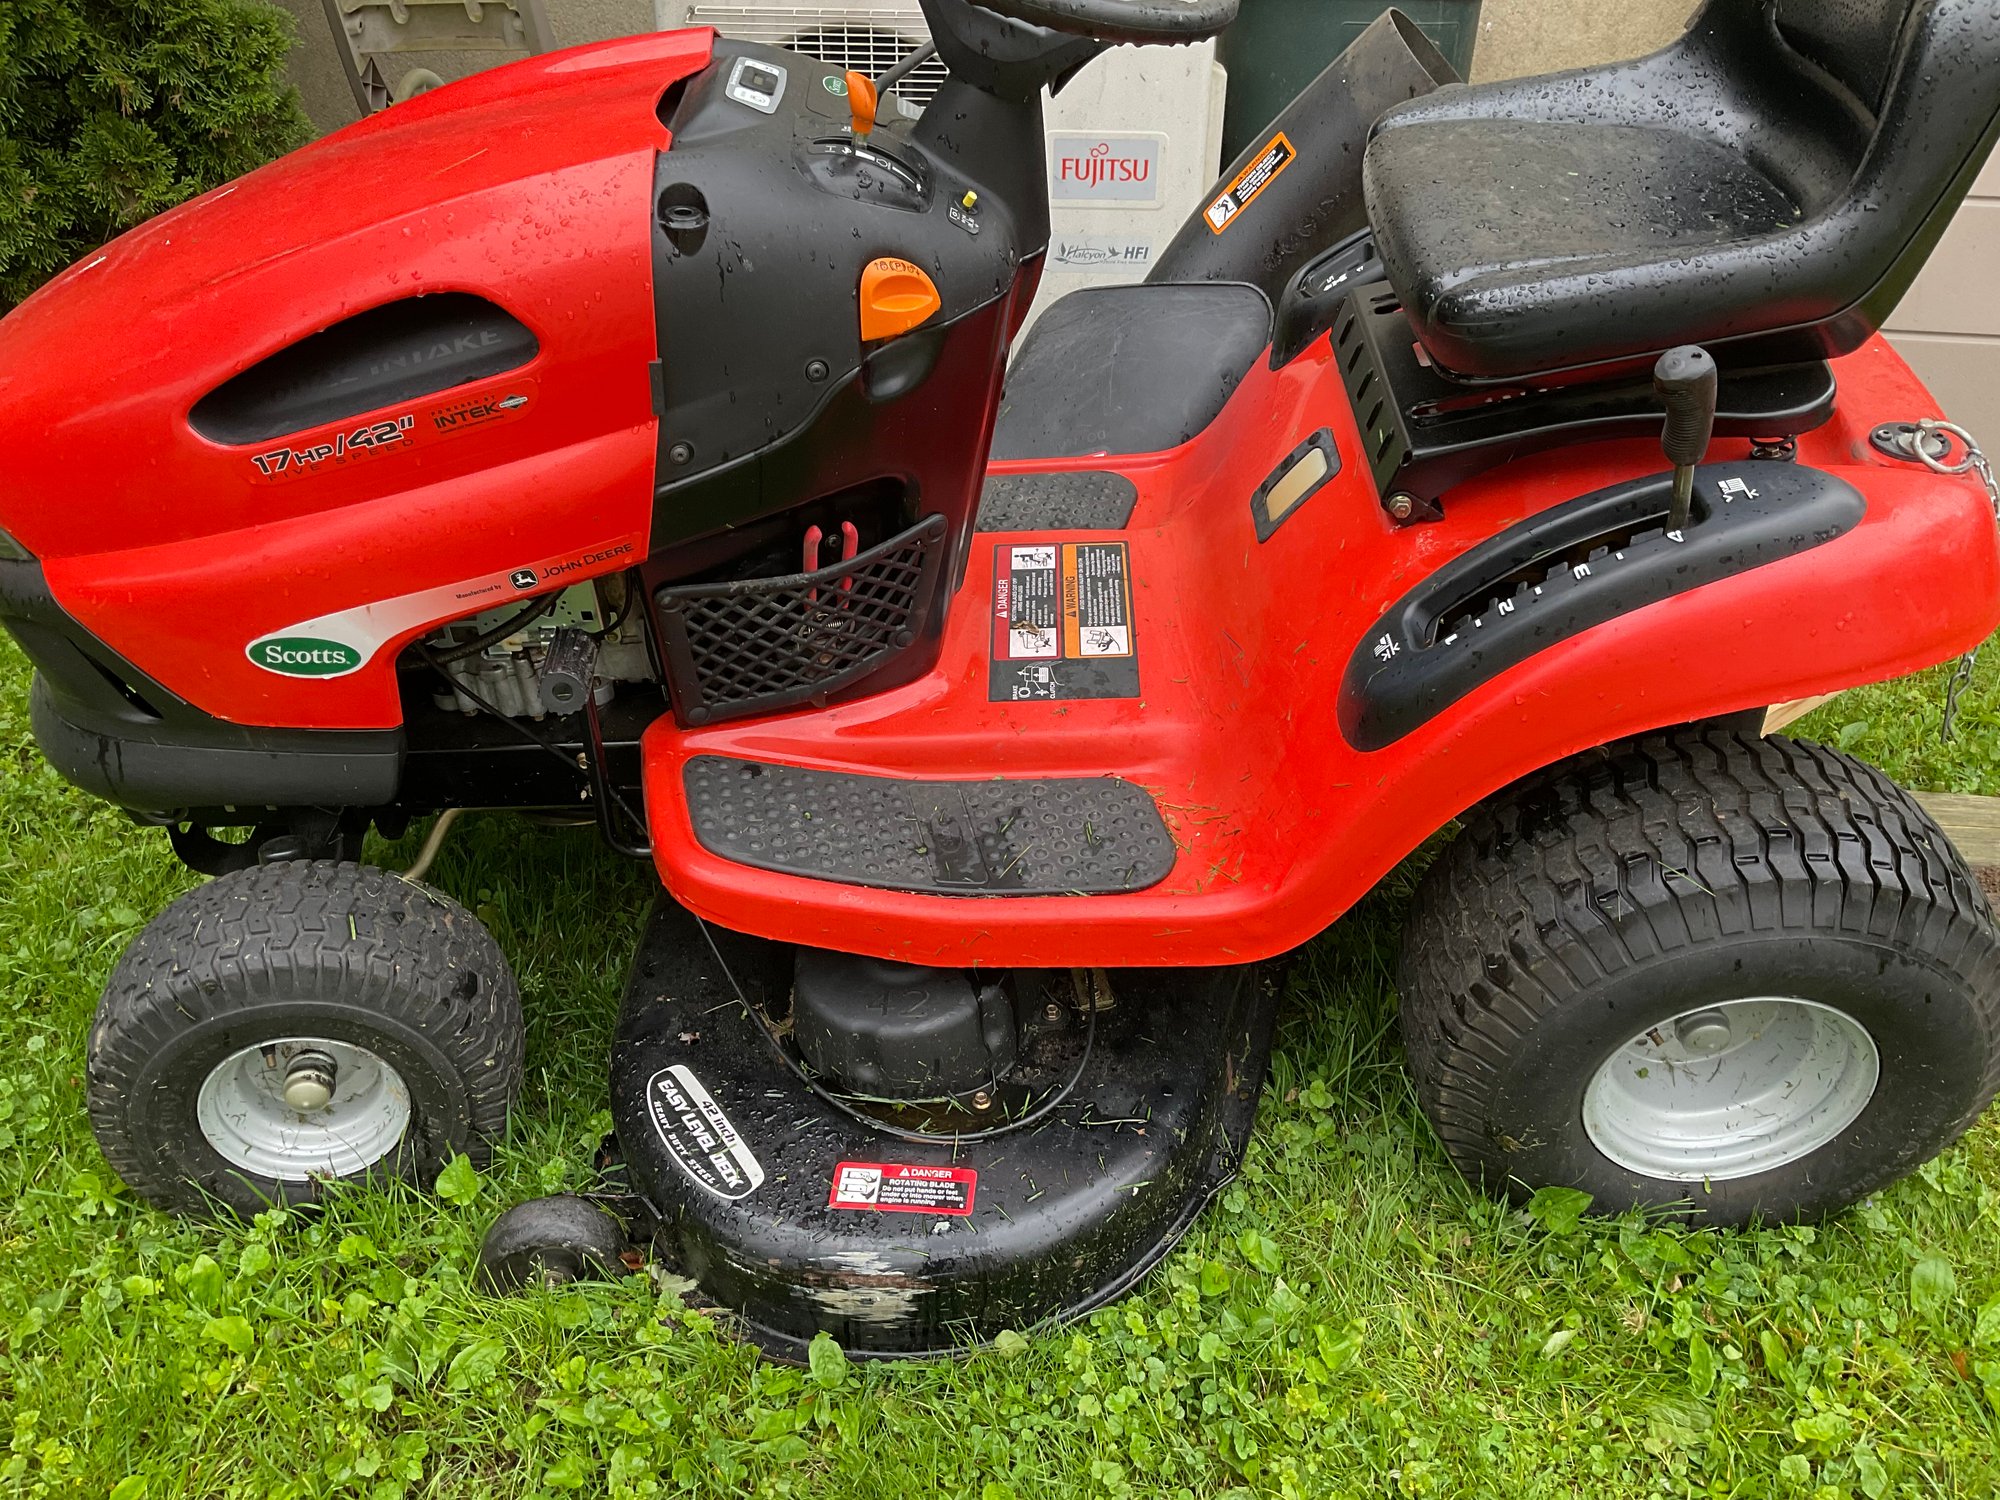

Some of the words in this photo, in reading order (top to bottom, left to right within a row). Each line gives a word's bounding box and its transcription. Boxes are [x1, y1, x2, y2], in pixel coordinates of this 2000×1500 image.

[1061, 158, 1149, 188] FUJITSU
[1243, 148, 1270, 176] WARNING
[1066, 244, 1106, 261] Halcyon
[1123, 246, 1149, 260] HFI
[433, 401, 502, 429] INTEK
[268, 462, 322, 482] FIVE
[335, 438, 415, 465] SPEED
[541, 559, 583, 580] JOHN
[582, 542, 635, 566] DEERE
[1573, 562, 1591, 580] 3
[455, 585, 494, 600] Manufactured
[494, 583, 502, 592] by
[998, 579, 1009, 609] DANGER
[1065, 576, 1076, 610] WARNING
[1498, 597, 1515, 616] 2
[1444, 633, 1458, 645] 1
[265, 645, 347, 664] Scotts
[702, 1100, 718, 1117] 42
[713, 1117, 737, 1143] inch
[653, 1101, 671, 1130] HEAVY
[668, 1133, 689, 1156] DUTY
[687, 1159, 716, 1184] STEEL
[657, 1079, 691, 1112] EASY
[680, 1112, 717, 1153] LEVEL
[708, 1152, 744, 1189] DECK
[889, 1178, 928, 1188] ROTATING
[929, 1181, 956, 1189] BLADE
[911, 1168, 953, 1179] DANGER
[910, 1198, 936, 1206] running
[946, 1194, 964, 1202] when
